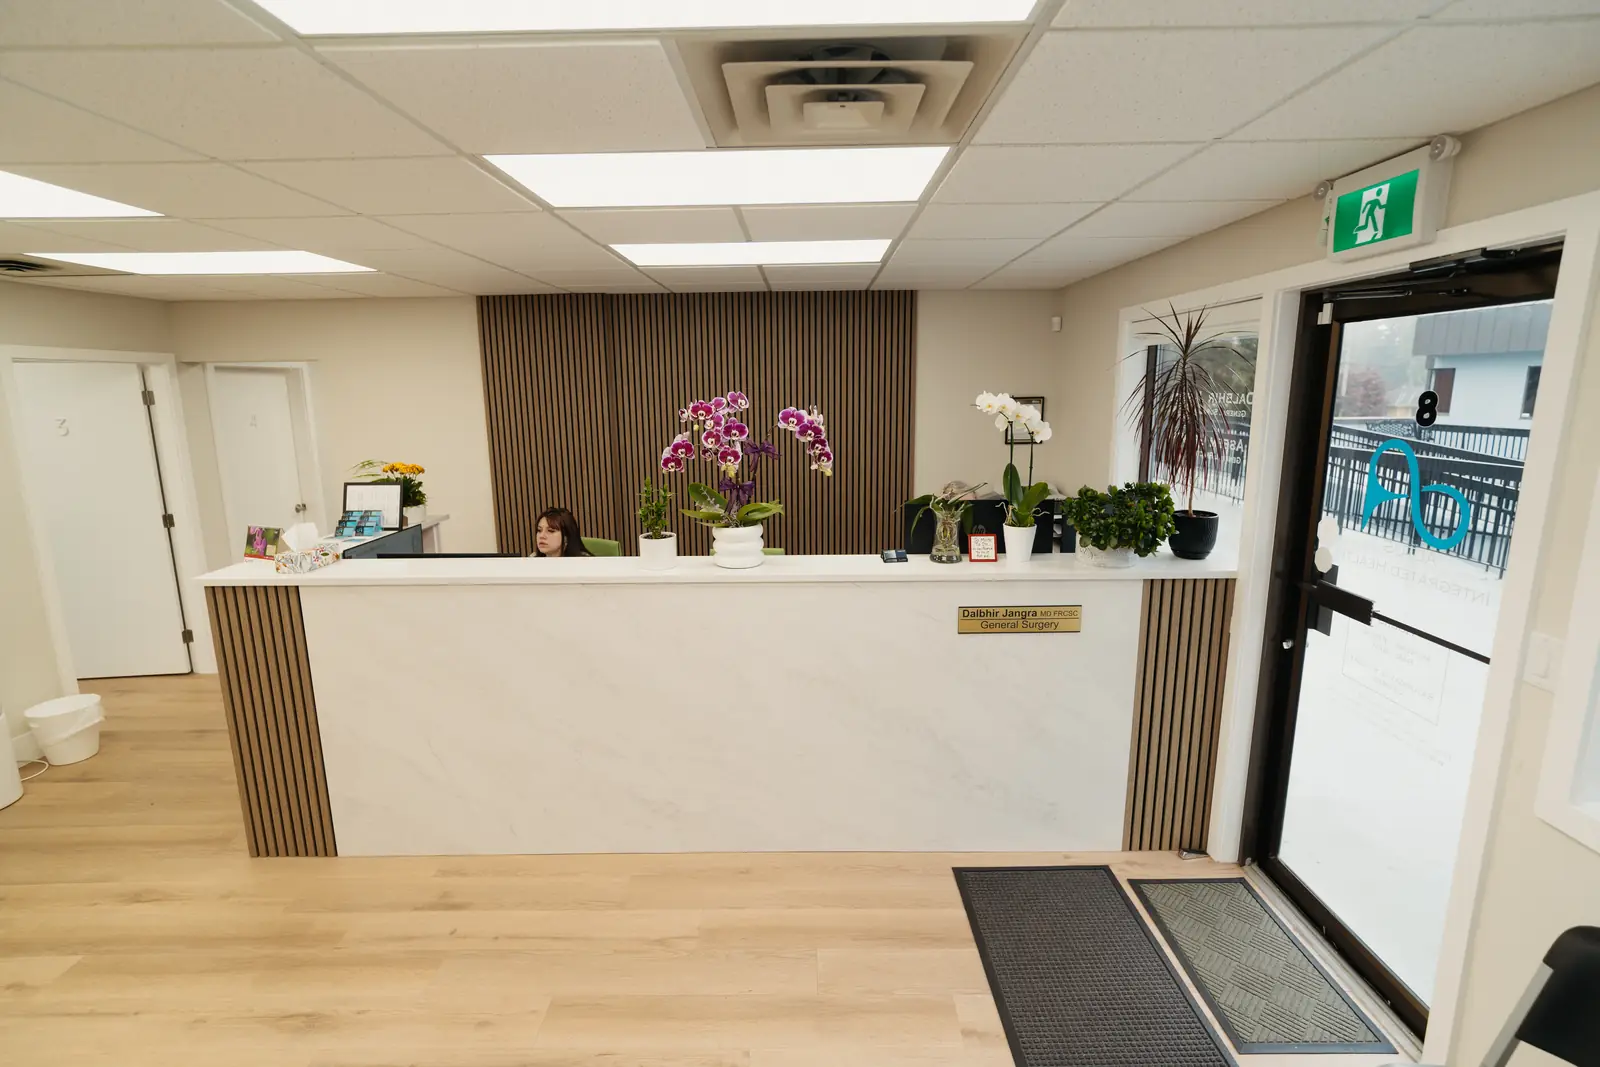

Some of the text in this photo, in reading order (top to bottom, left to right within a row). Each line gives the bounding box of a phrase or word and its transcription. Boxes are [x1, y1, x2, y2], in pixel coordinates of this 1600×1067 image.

[1416, 390, 1438, 427] 8
[55, 418, 70, 437] 3
[962, 609, 999, 618] Dalbhir
[1002, 609, 1038, 620] Jangra
[980, 620, 1060, 631] General Surgery
